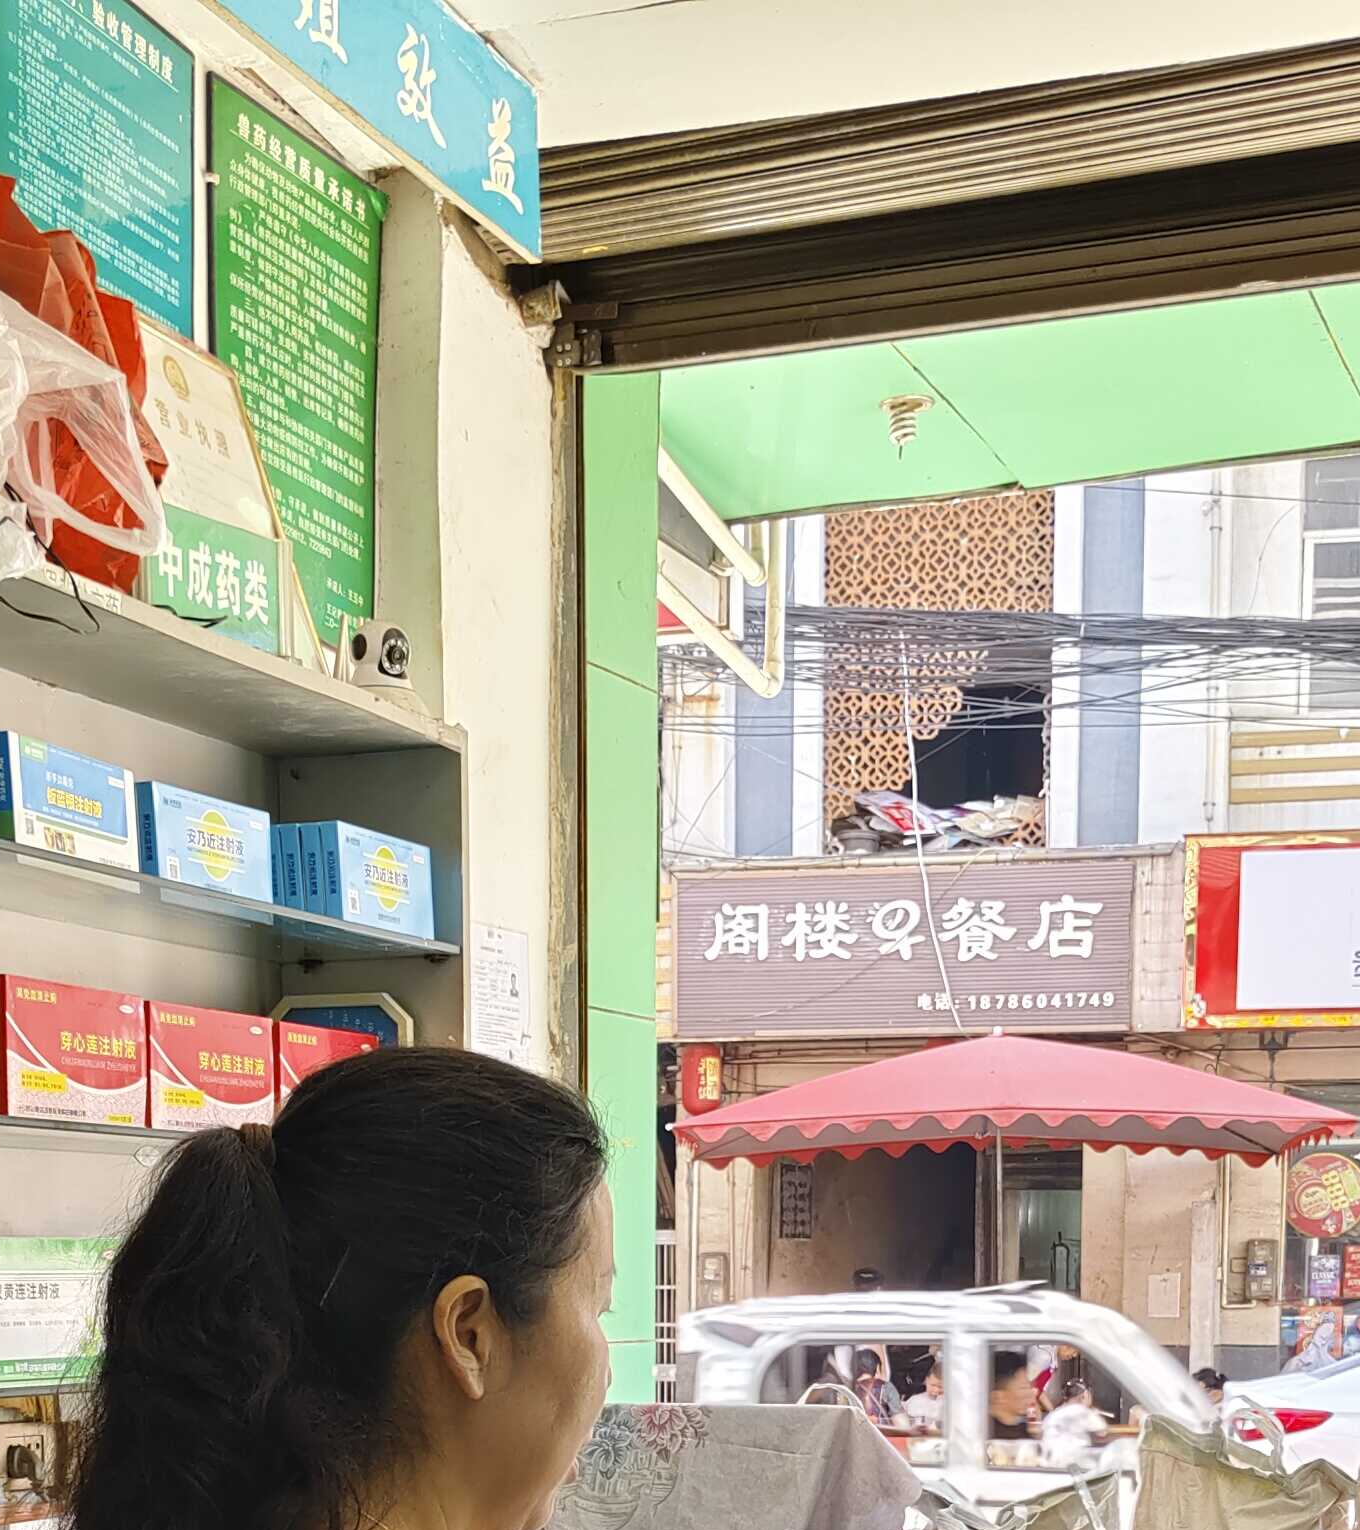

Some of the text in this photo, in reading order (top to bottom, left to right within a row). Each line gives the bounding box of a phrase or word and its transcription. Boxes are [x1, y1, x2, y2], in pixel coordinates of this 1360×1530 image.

[70, 0, 173, 84] 、验收管理制度
[156, 531, 271, 626] 中成药类
[185, 825, 245, 858] 安乃近注射液
[362, 862, 410, 890] 安乃近注射液
[59, 1031, 137, 1061] 穿心莲注射液
[198, 1051, 266, 1077] 穿心莲注射液
